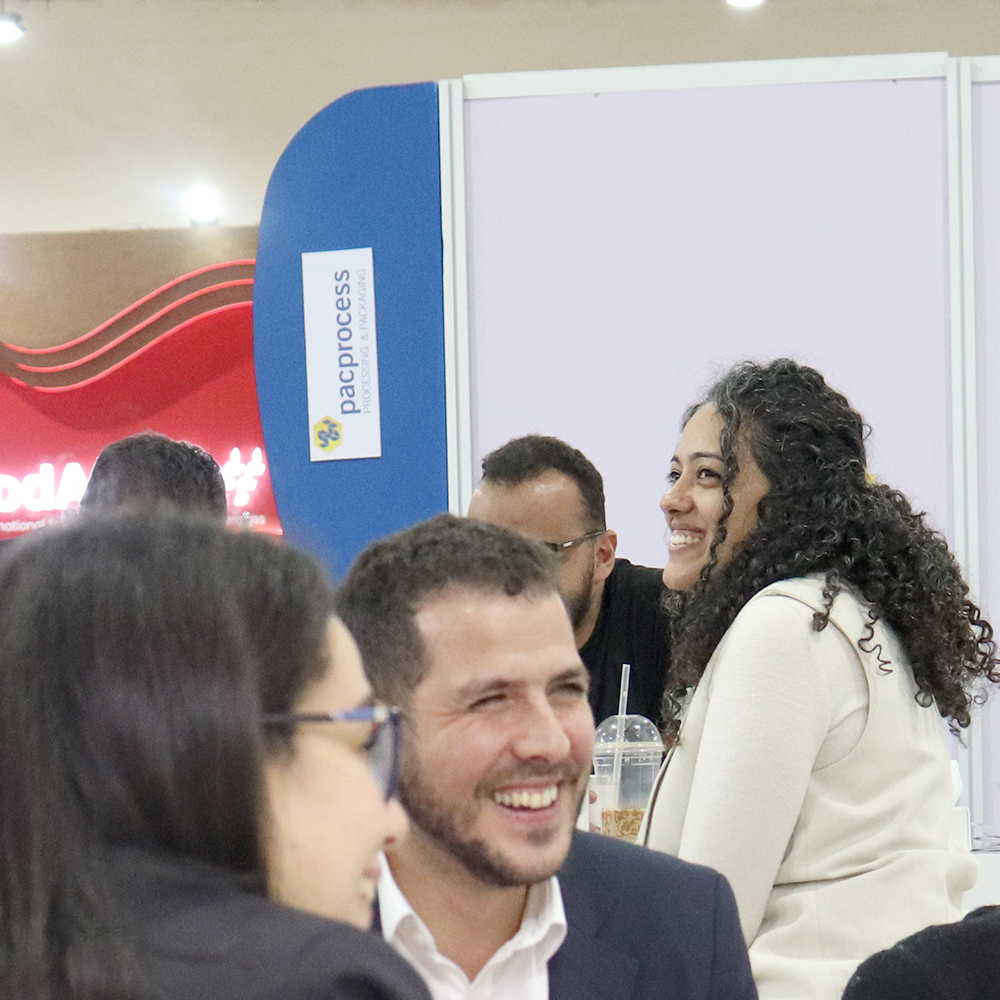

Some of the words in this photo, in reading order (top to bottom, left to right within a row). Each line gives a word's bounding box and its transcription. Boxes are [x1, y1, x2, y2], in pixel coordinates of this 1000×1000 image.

[357, 268, 369, 331] PACKAGING
[334, 269, 361, 415] pacprocess
[360, 333, 368, 341] &
[359, 346, 372, 414] PROCESSING
